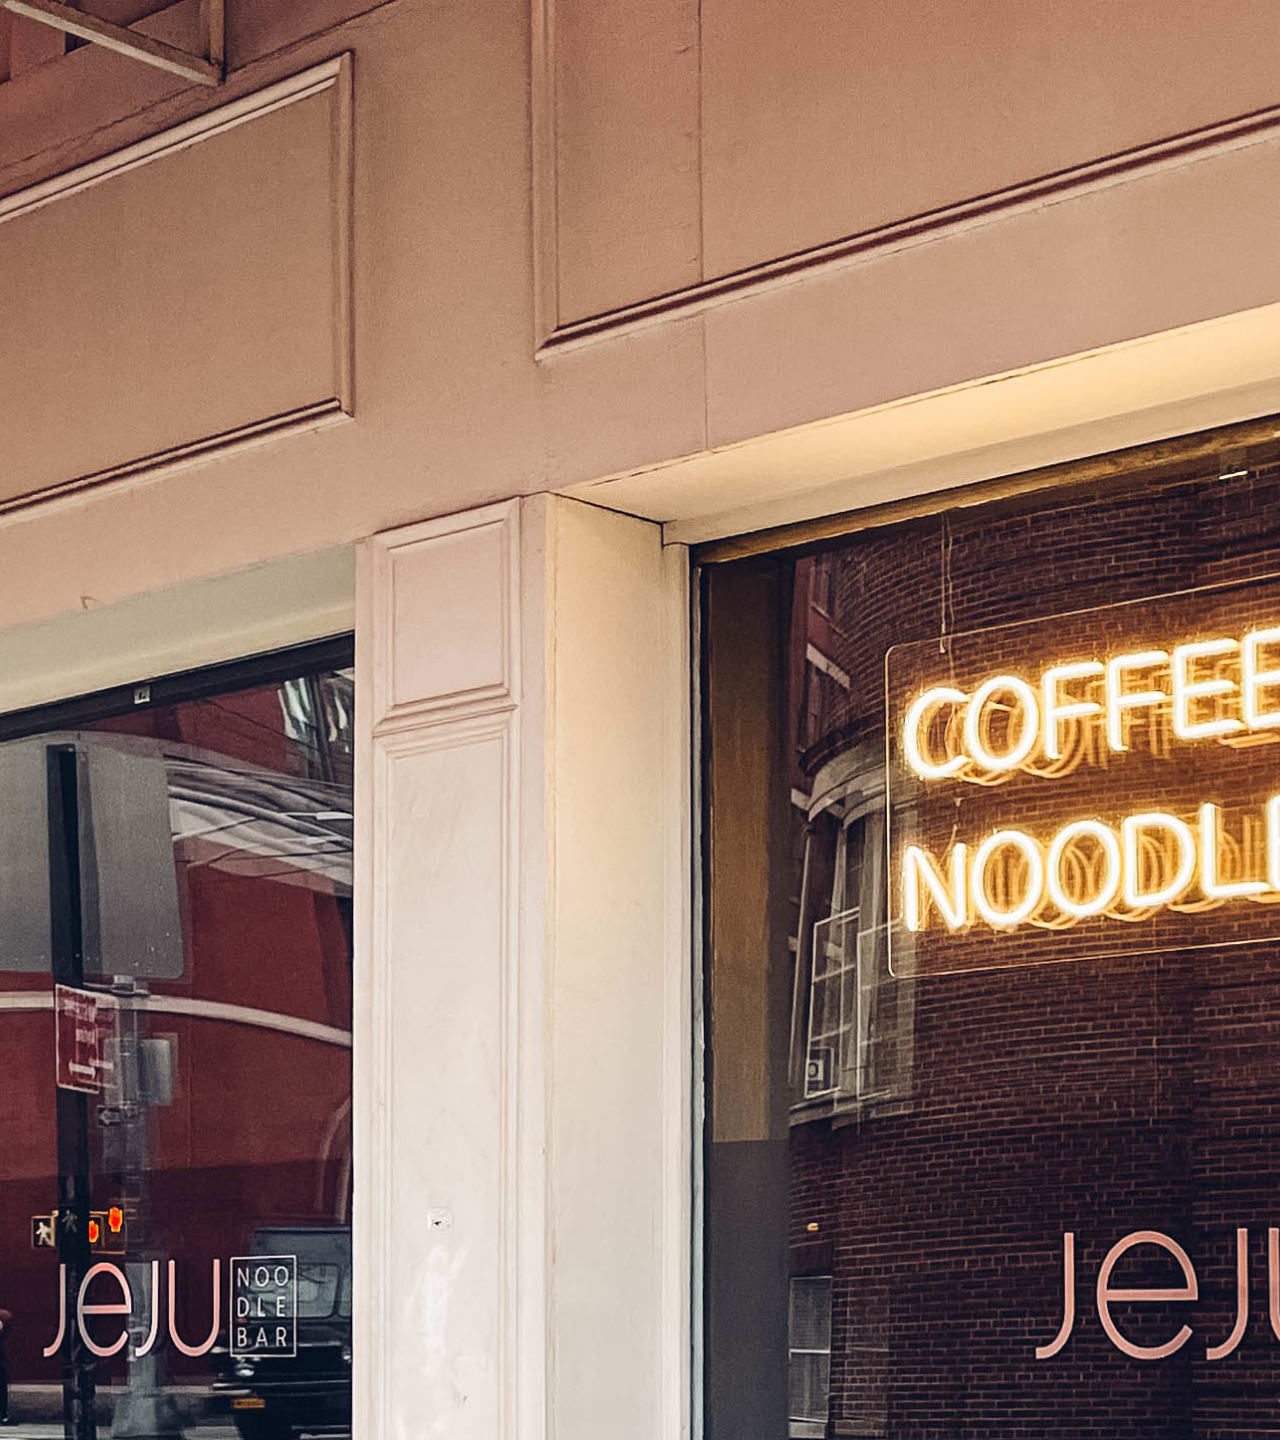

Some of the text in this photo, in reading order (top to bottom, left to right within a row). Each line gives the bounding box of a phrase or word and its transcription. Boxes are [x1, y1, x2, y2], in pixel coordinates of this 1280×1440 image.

[236, 1266, 290, 1288] NOO
[236, 1296, 287, 1318] DLE
[236, 1326, 288, 1348] BAR
